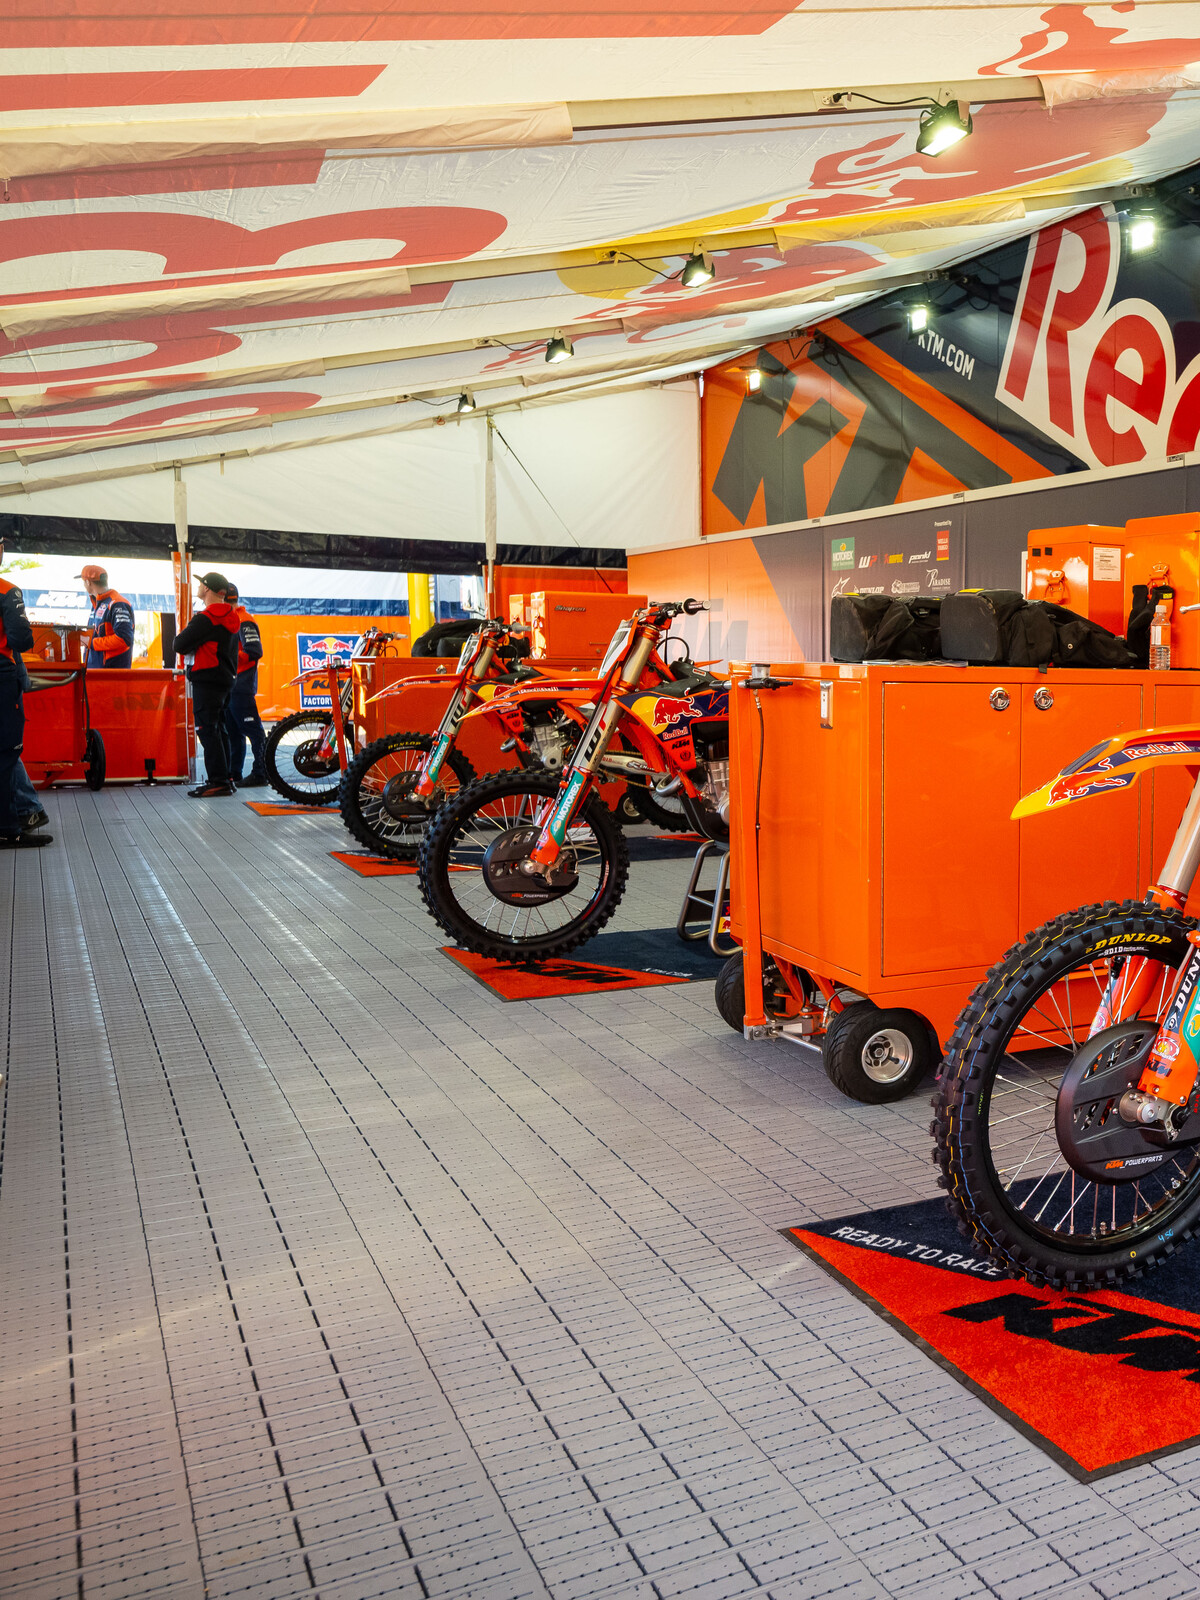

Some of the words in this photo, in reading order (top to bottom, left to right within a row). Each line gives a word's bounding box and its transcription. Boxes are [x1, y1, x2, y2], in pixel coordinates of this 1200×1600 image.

[917, 329, 975, 380] KTM.COM
[832, 550, 854, 562] MOTOREX
[858, 555, 878, 569] WP
[671, 740, 690, 749] KTM
[1122, 744, 1157, 760] Red
[1156, 741, 1192, 755] Bull
[558, 781, 582, 821] MOTOREX
[1092, 933, 1172, 951] DUNLOP
[1145, 1060, 1173, 1077] KTM
[831, 1226, 910, 1257] READY
[907, 1241, 943, 1265] TO
[941, 1250, 1003, 1278] RACE
